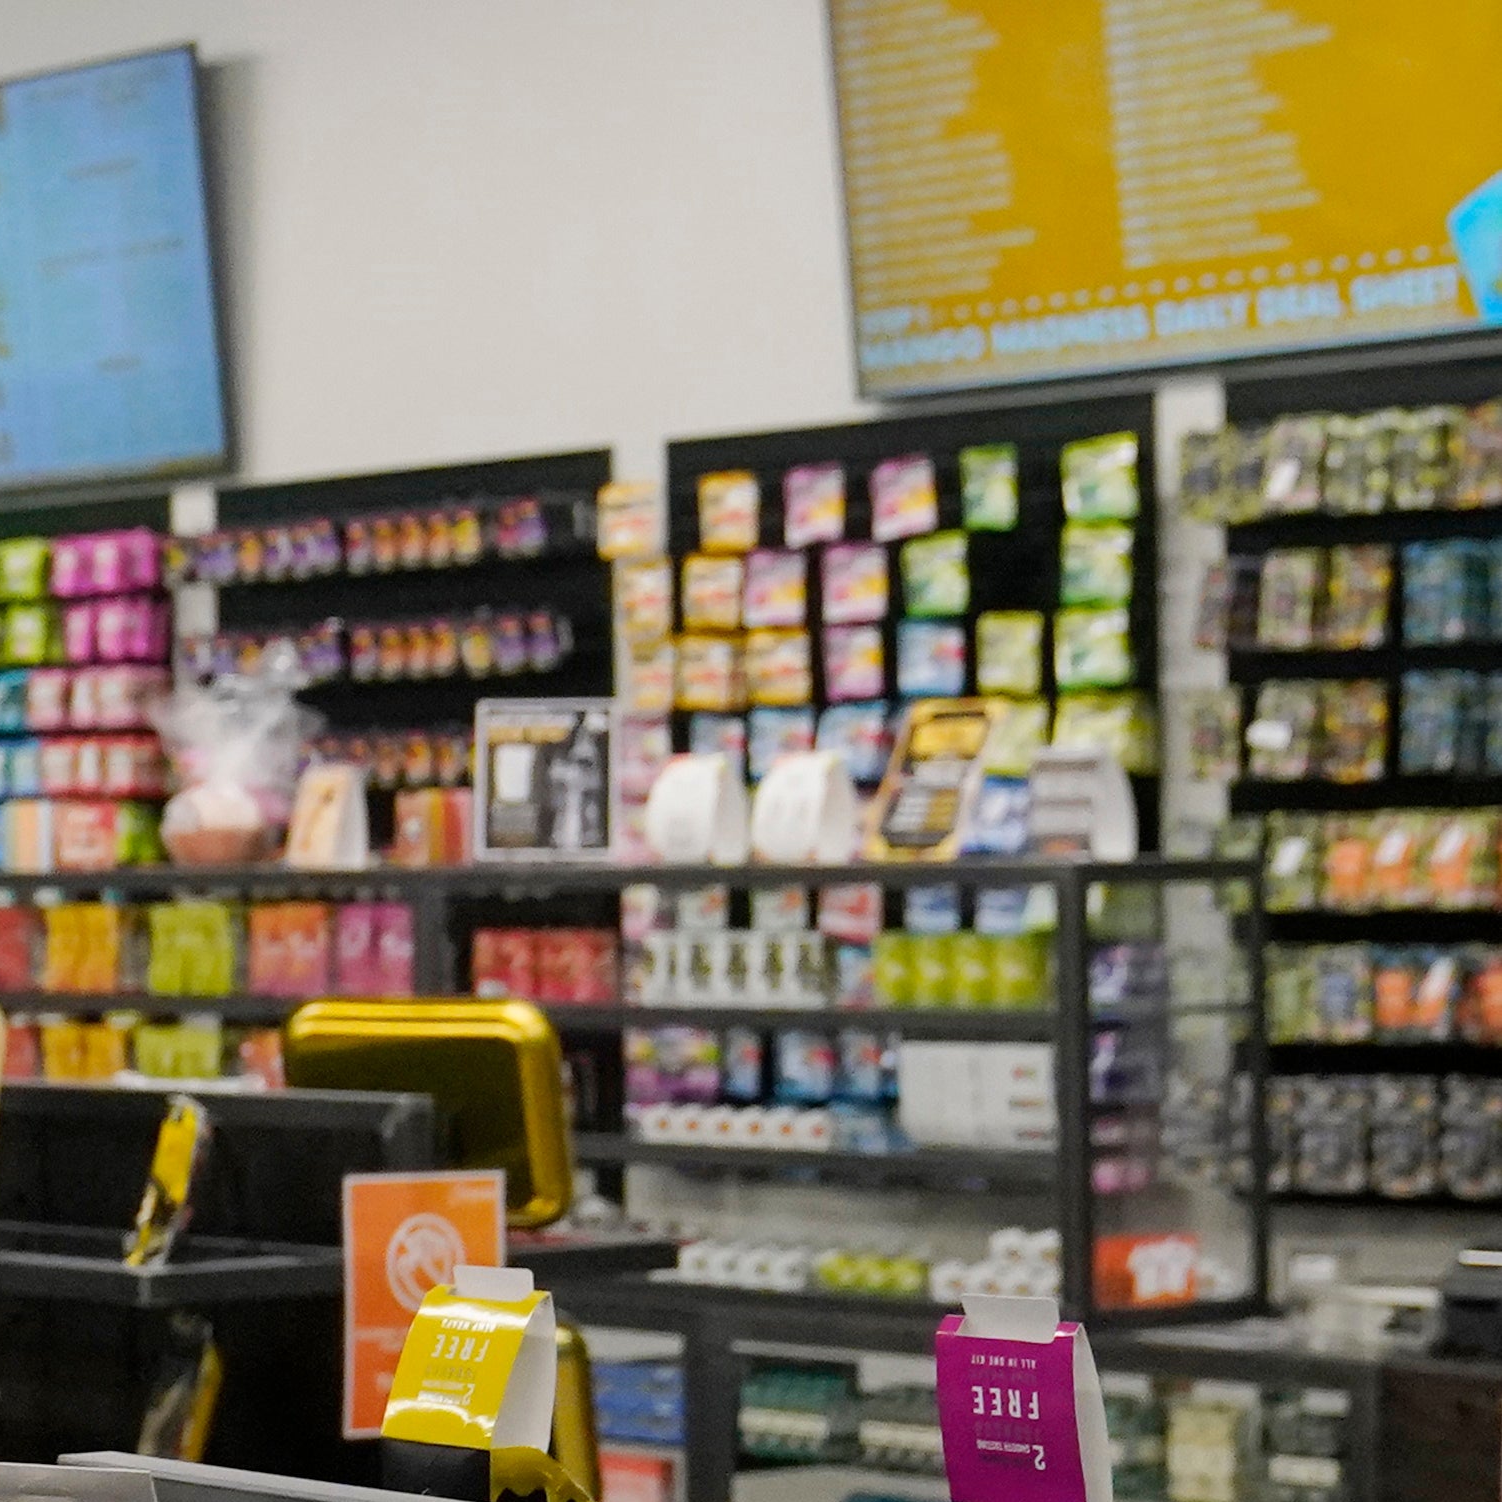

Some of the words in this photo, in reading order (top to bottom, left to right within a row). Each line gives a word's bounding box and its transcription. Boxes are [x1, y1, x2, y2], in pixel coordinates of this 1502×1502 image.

[431, 1333, 491, 1362] FREE
[971, 1386, 1040, 1420] FREE
[1032, 1444, 1046, 1470] 2
